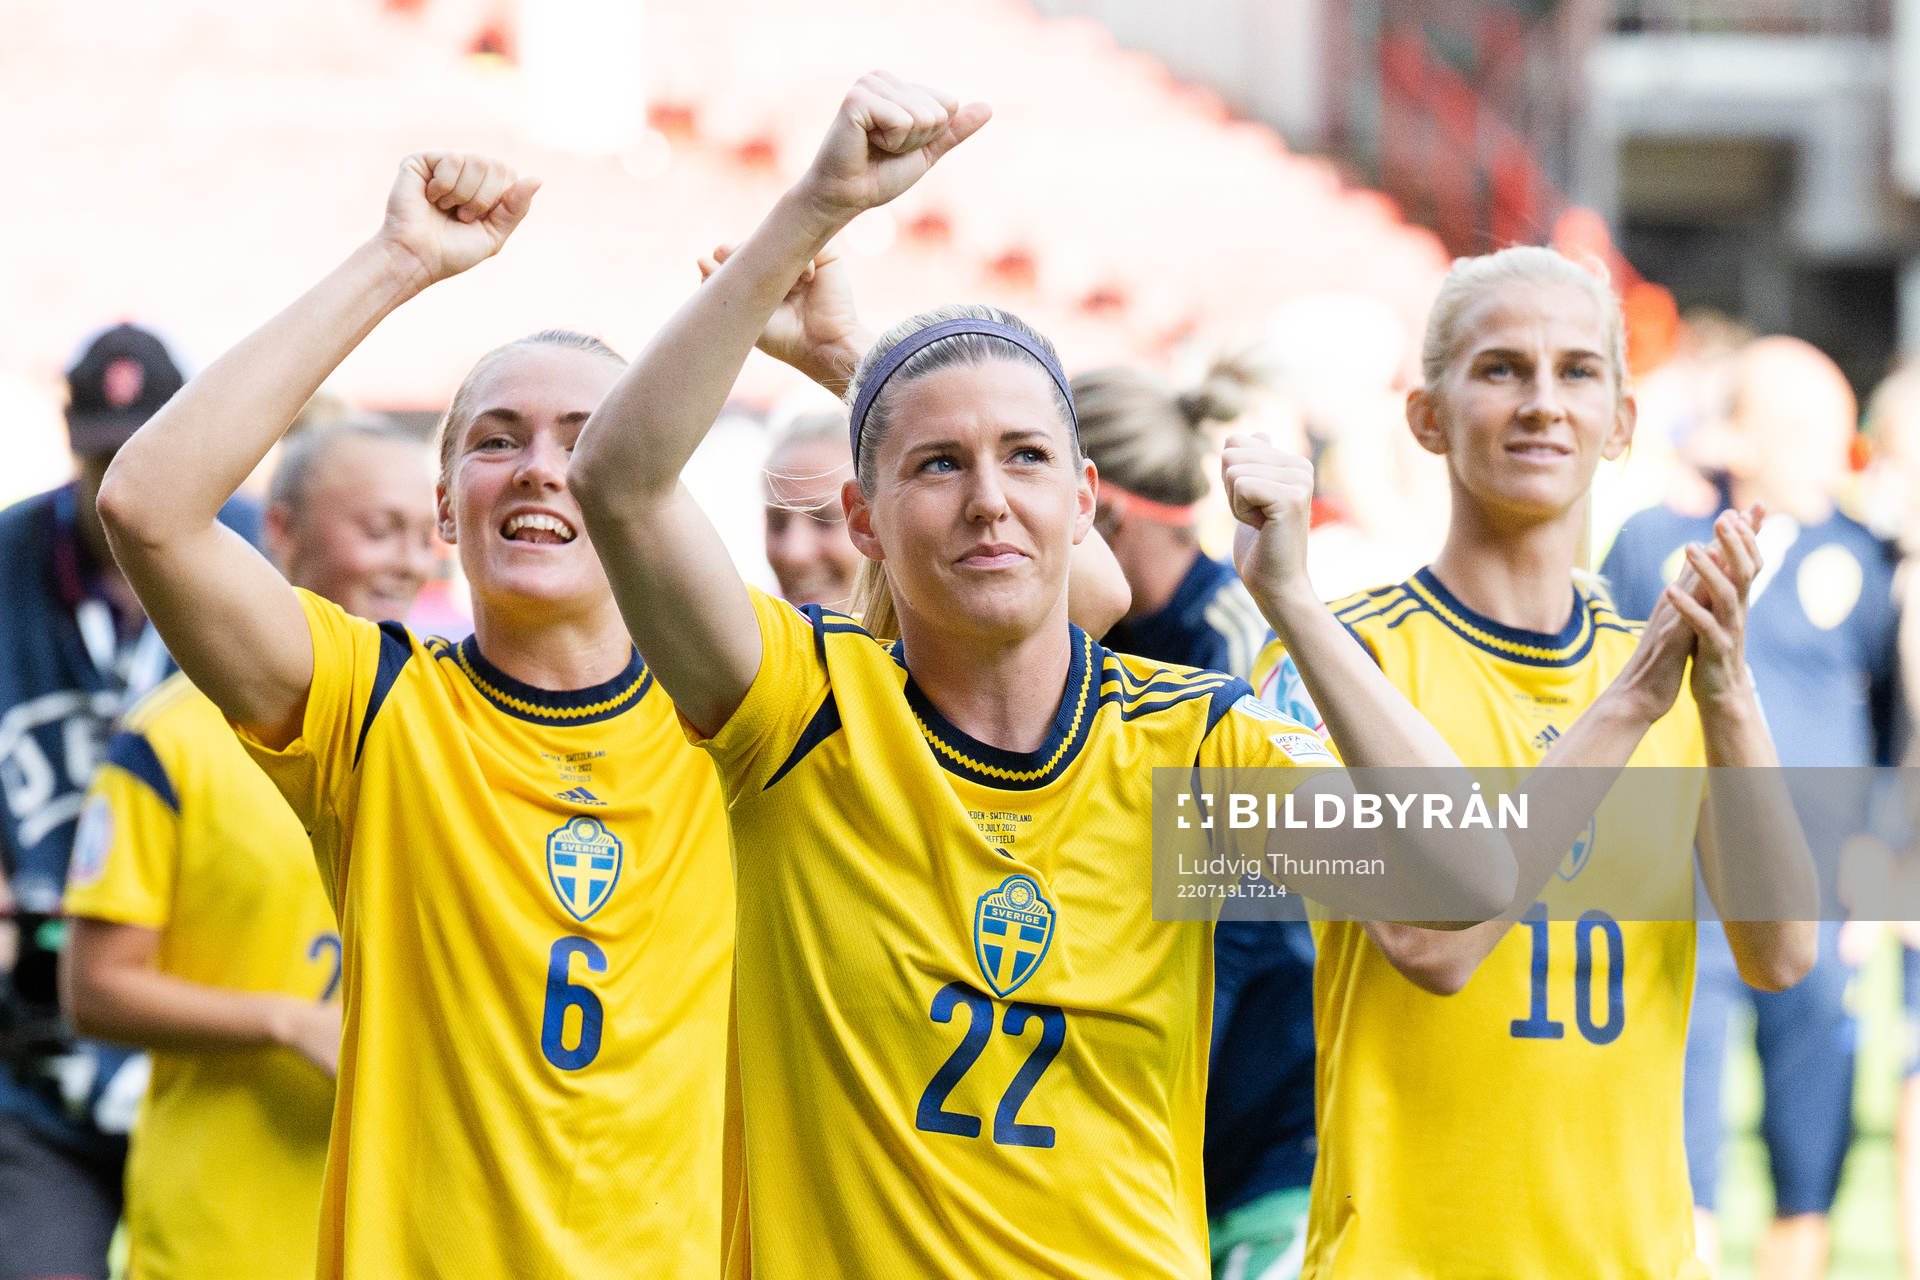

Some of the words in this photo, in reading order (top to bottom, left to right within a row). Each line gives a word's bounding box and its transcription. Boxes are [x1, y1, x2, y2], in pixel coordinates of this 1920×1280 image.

[968, 811, 985, 820] EDEN
[990, 811, 1032, 822] SWITZERLAND
[985, 823, 1000, 832] JULY
[1002, 823, 1016, 832] 2022
[985, 835, 1015, 844] HEFFIELD
[561, 843, 608, 855] SVERIGE
[991, 907, 1040, 925] SVERIGE
[1510, 902, 1625, 1045] 10
[541, 935, 608, 1071] 6
[916, 981, 1067, 1148] 22
